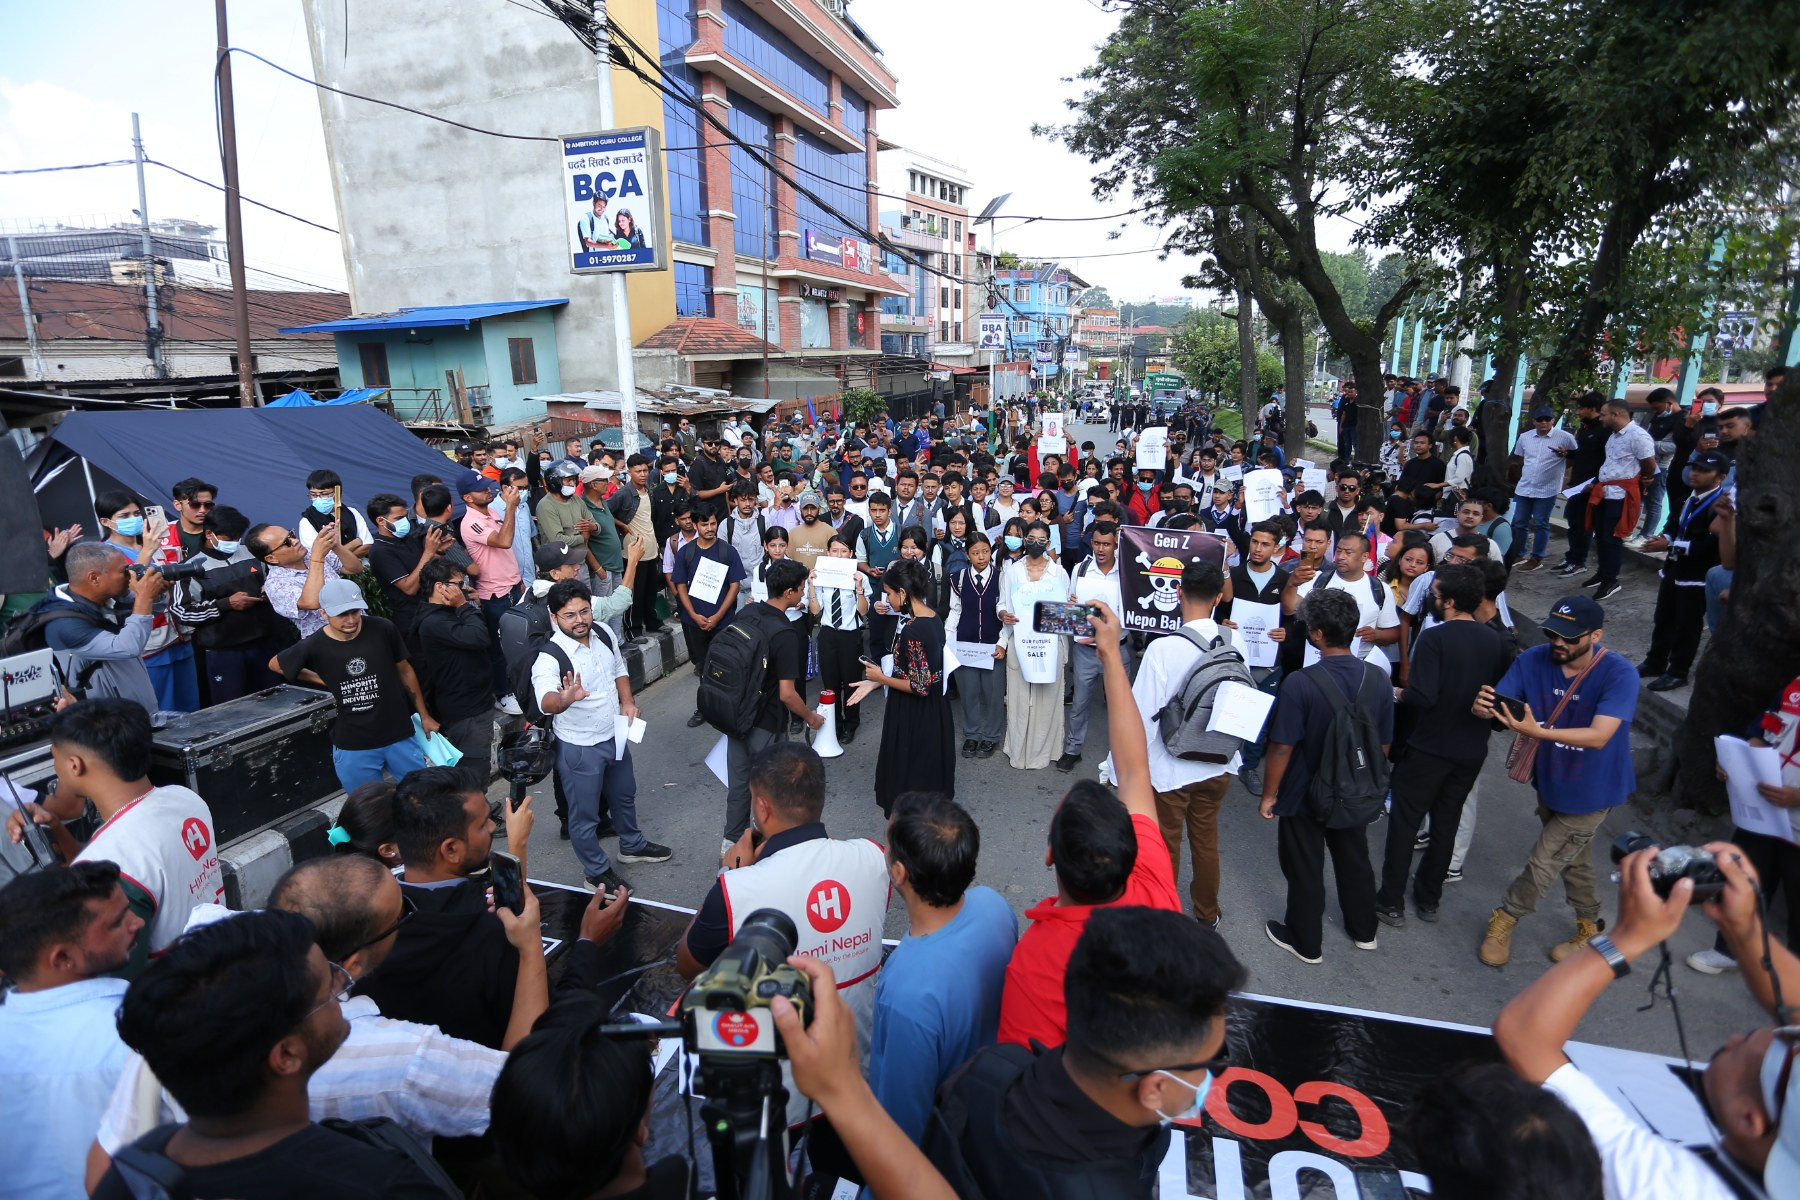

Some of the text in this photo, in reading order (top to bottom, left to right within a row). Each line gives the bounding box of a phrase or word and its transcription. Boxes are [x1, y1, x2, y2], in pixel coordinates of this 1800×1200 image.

[571, 135, 643, 148] AMBITION GURU COLLEGE
[573, 169, 643, 202] BCA
[589, 253, 637, 265] 01-5970287
[981, 324, 1003, 332] BBA
[1154, 533, 1191, 550] Gen Z
[1125, 610, 1157, 630] Nepo
[341, 678, 377, 691] MINORITY
[355, 683, 379, 693] EARTH
[343, 692, 380, 705] INDIVIDUAL
[832, 928, 872, 952] Nepal
[833, 955, 841, 963] by
